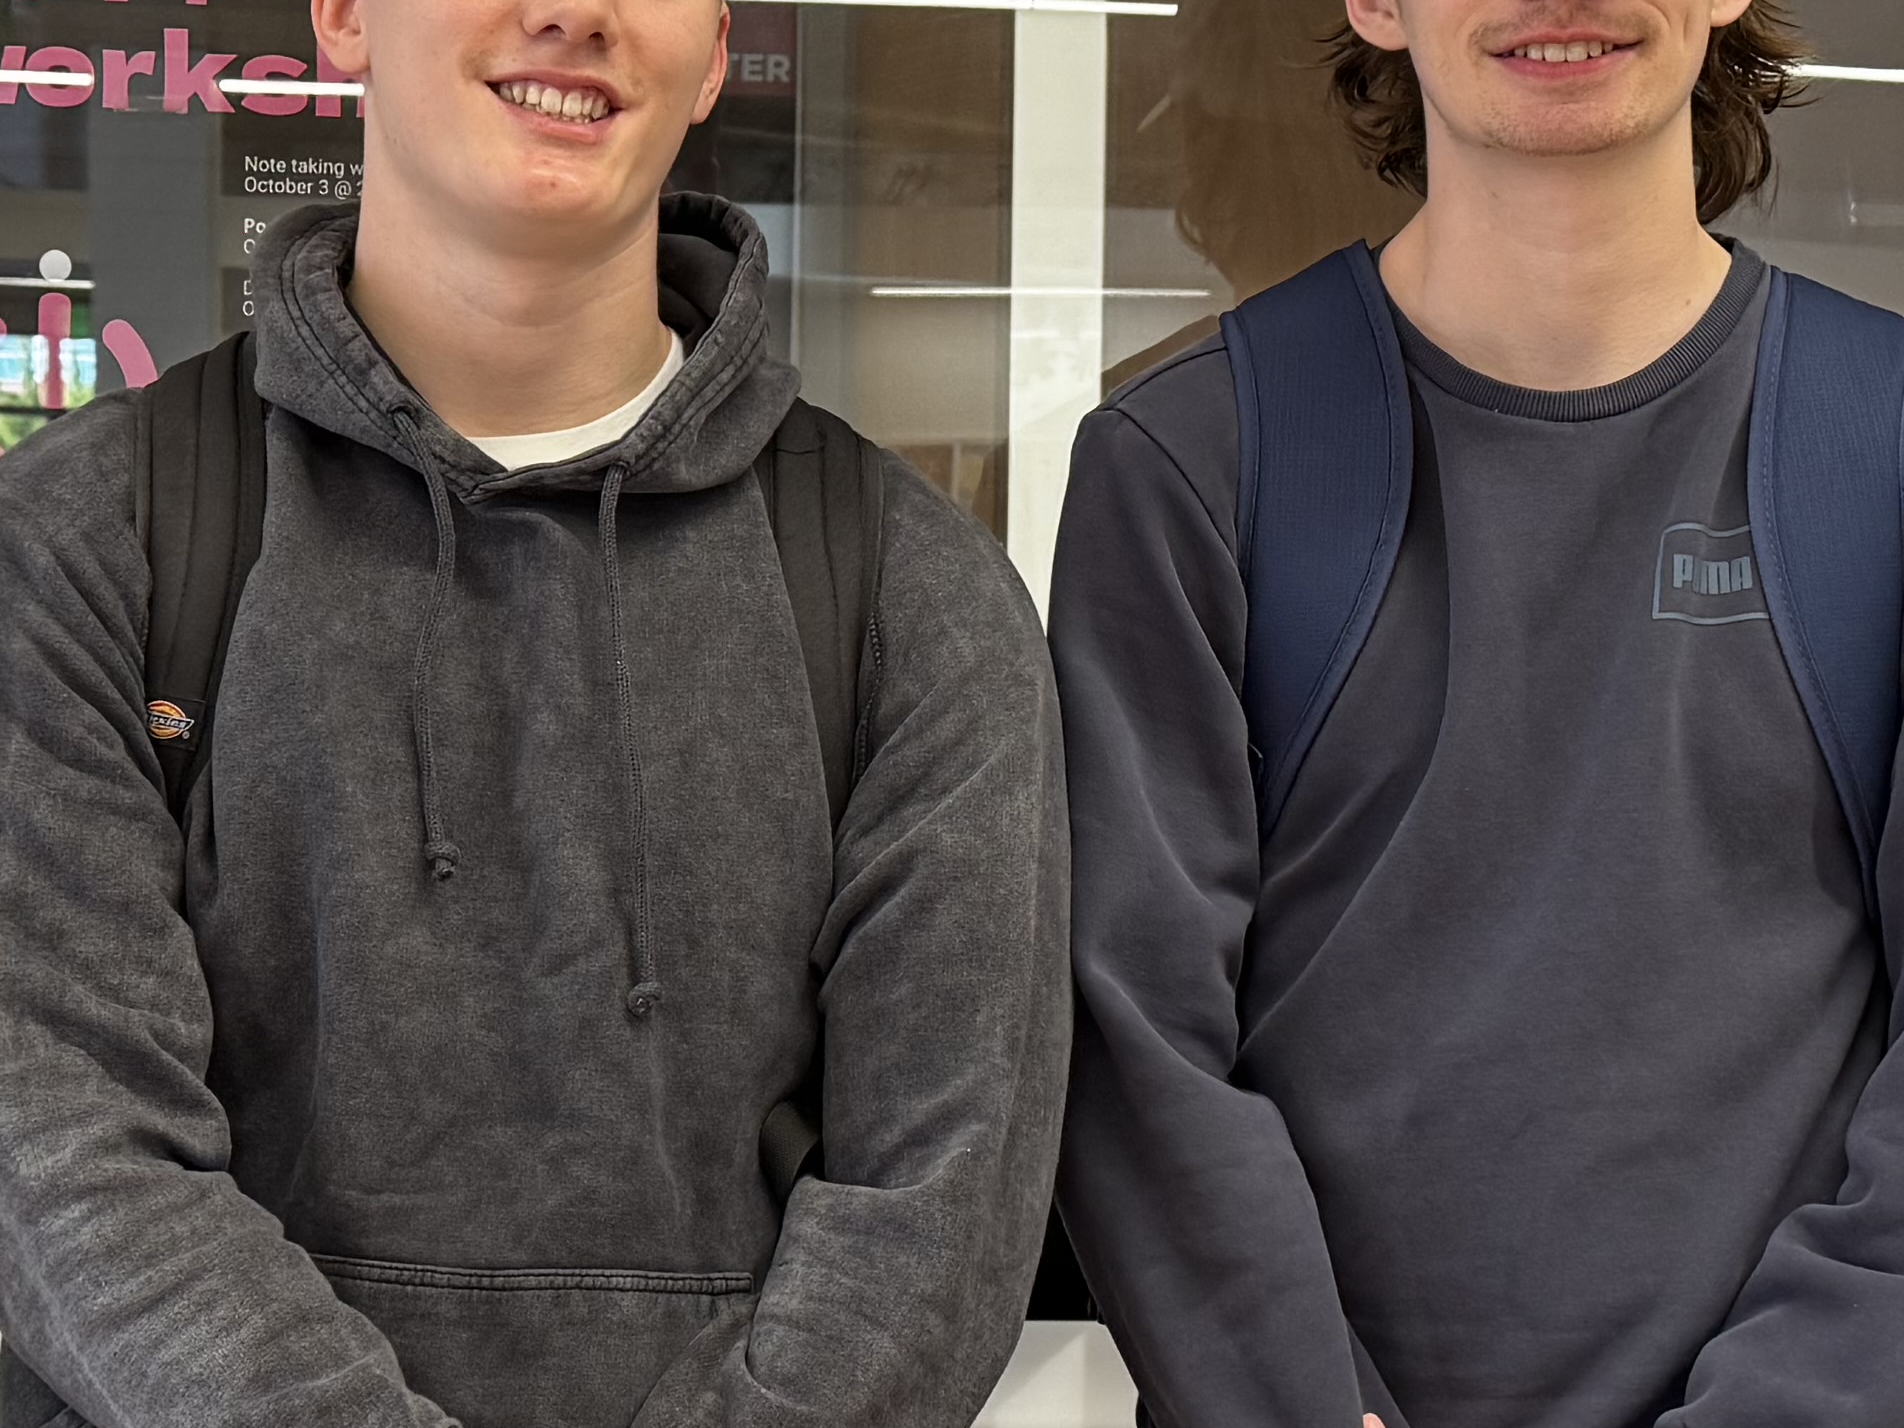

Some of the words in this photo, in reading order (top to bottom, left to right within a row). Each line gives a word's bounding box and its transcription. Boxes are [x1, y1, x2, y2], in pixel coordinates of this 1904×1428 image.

[245, 156, 287, 173] Note
[291, 157, 345, 179] taking
[244, 176, 314, 195] October
[318, 179, 329, 195] 3
